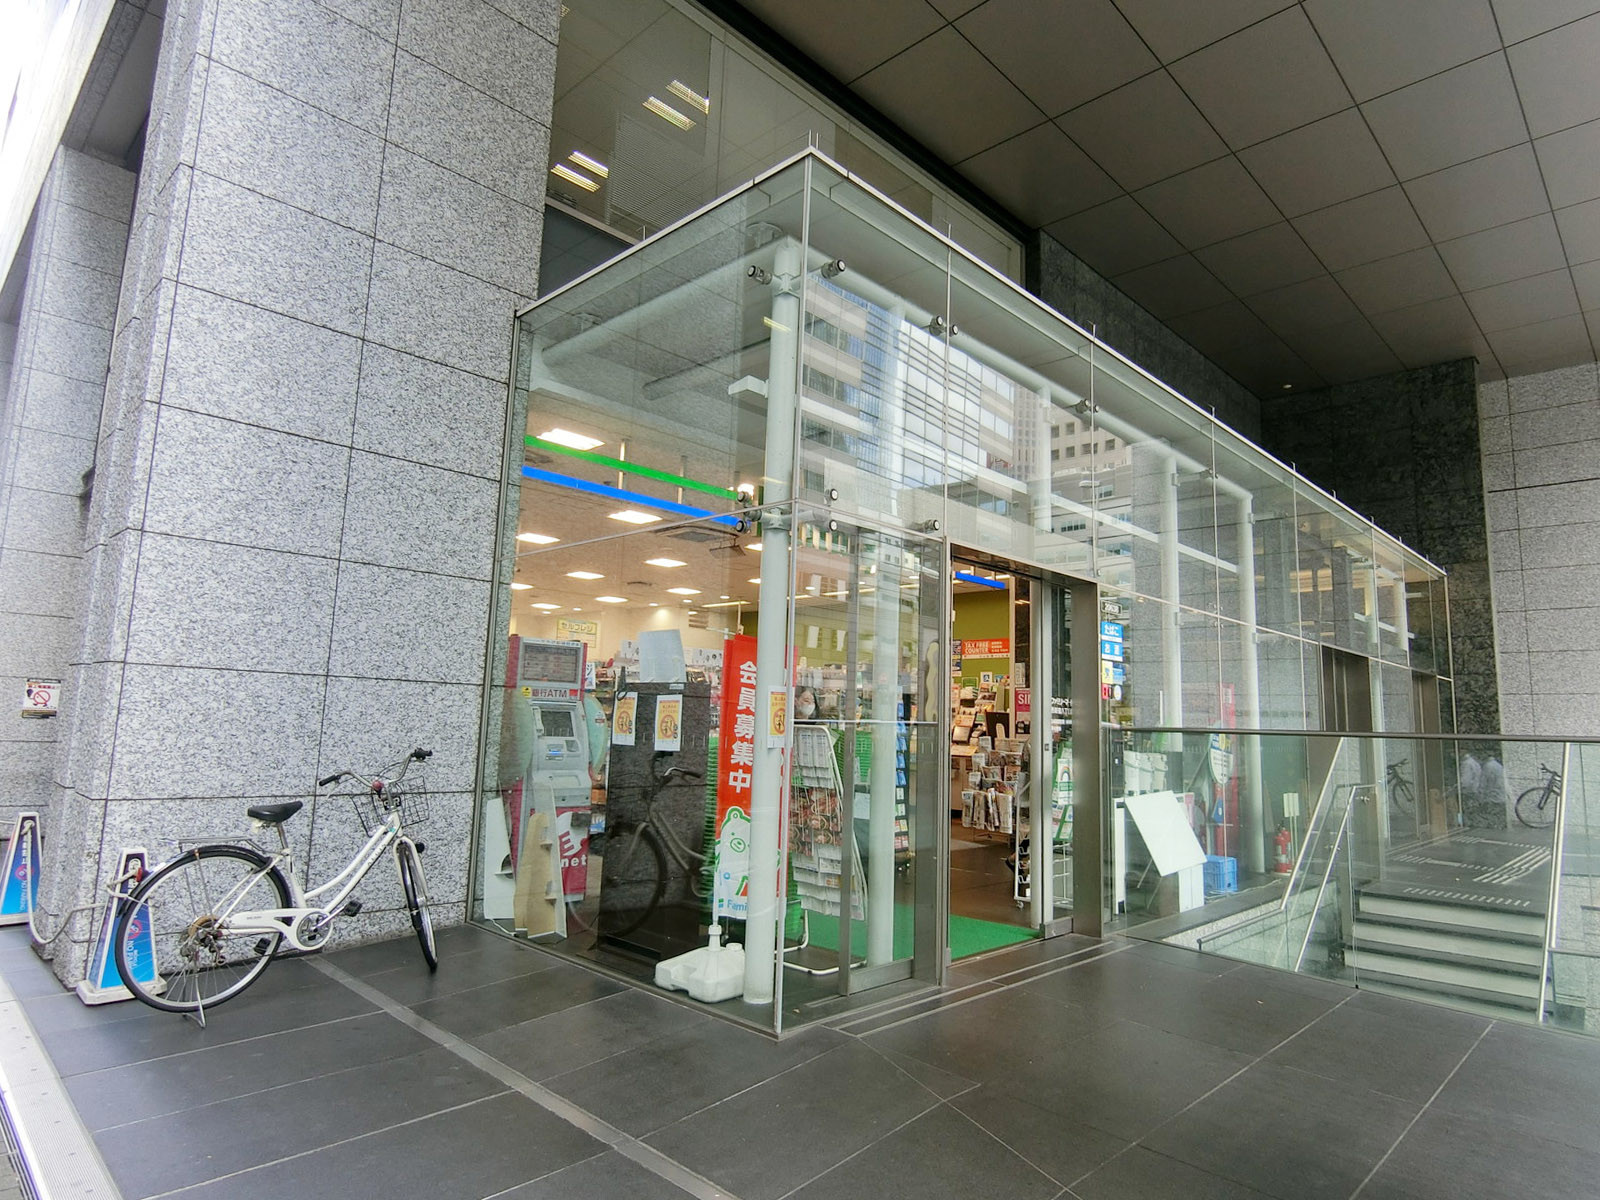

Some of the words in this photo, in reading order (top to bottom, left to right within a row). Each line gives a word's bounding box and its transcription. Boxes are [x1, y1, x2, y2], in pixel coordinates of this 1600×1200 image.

[561, 622, 594, 632] セルフレジ
[532, 688, 568, 698] 銀行ATM
[728, 660, 757, 794] 会員募集中
[561, 854, 587, 868] net
[127, 940, 134, 952] NO
